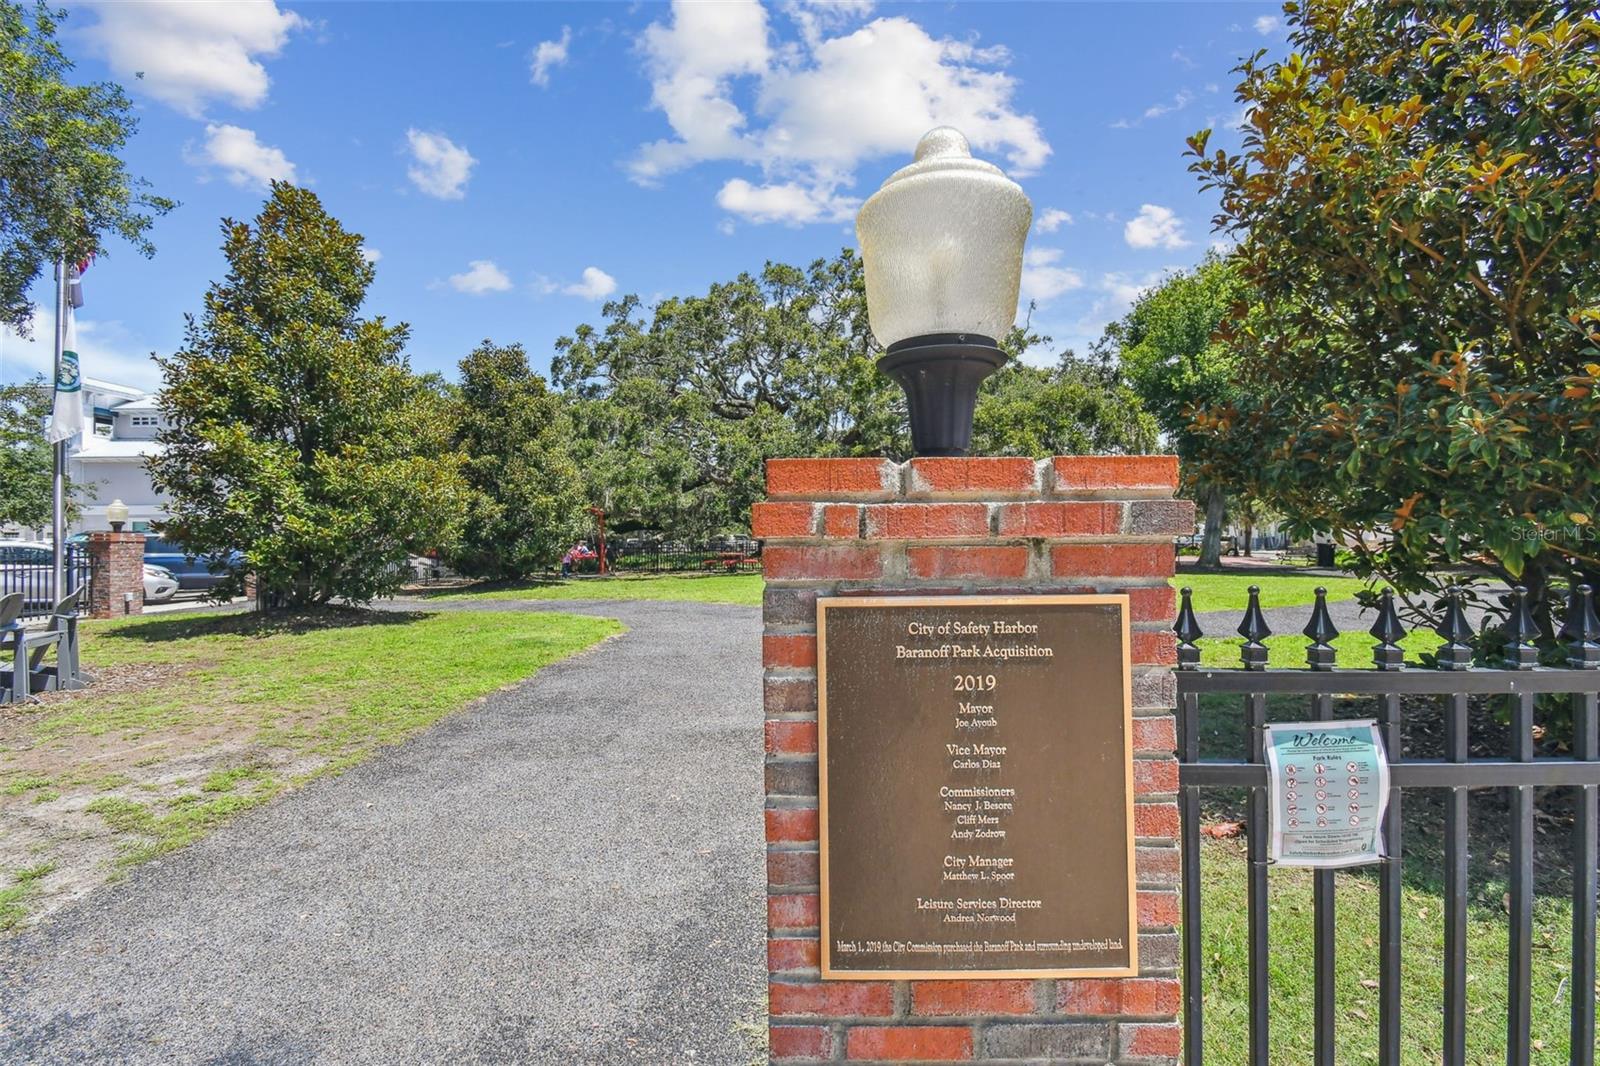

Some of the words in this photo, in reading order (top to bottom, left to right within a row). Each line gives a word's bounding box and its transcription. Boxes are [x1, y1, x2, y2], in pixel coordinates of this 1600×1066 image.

[908, 623, 934, 637] City
[938, 622, 951, 635] of
[953, 622, 990, 637] Safety
[993, 622, 1037, 634] Harbor
[896, 646, 950, 658] Baranoff
[953, 646, 980, 657] Park
[984, 646, 1053, 659] Acquisition
[954, 675, 996, 692] 2019
[959, 703, 993, 716] Mayor
[955, 718, 968, 729] Joe
[970, 718, 997, 728] Ayoub
[1293, 732, 1356, 747] Welcome
[947, 745, 970, 755] Vice
[973, 745, 1007, 756] Mayor
[953, 760, 980, 769] Carlos
[982, 760, 1001, 768] Diaz
[940, 787, 1015, 798] Commissioners
[945, 802, 972, 812] Nancy
[975, 802, 982, 811] J.
[984, 801, 1012, 810] Besore
[957, 815, 976, 825] Cliff
[951, 830, 973, 839] Andy
[975, 829, 1005, 838] Zodrow
[944, 856, 966, 869] City
[968, 856, 1014, 869] Manager
[944, 871, 979, 880] Matthew
[981, 872, 989, 880] L.
[992, 871, 1015, 882] Spoor
[917, 898, 954, 909] Leisure
[956, 898, 997, 909] Services
[1000, 898, 1041, 909] Director
[944, 913, 974, 923] Andrea
[976, 913, 1016, 922] Norwood
[836, 941, 856, 952] March
[866, 941, 881, 952] 2019
[882, 941, 892, 952] the
[893, 941, 905, 953] City
[907, 941, 942, 952] Commission
[943, 941, 973, 953] purchased
[973, 941, 983, 952] the
[984, 941, 1009, 952] Baranoff
[1010, 941, 1024, 952] Park
[1025, 941, 1035, 951] and
[1037, 940, 1071, 952] surrounding
[1072, 939, 1108, 952] undeveloped
